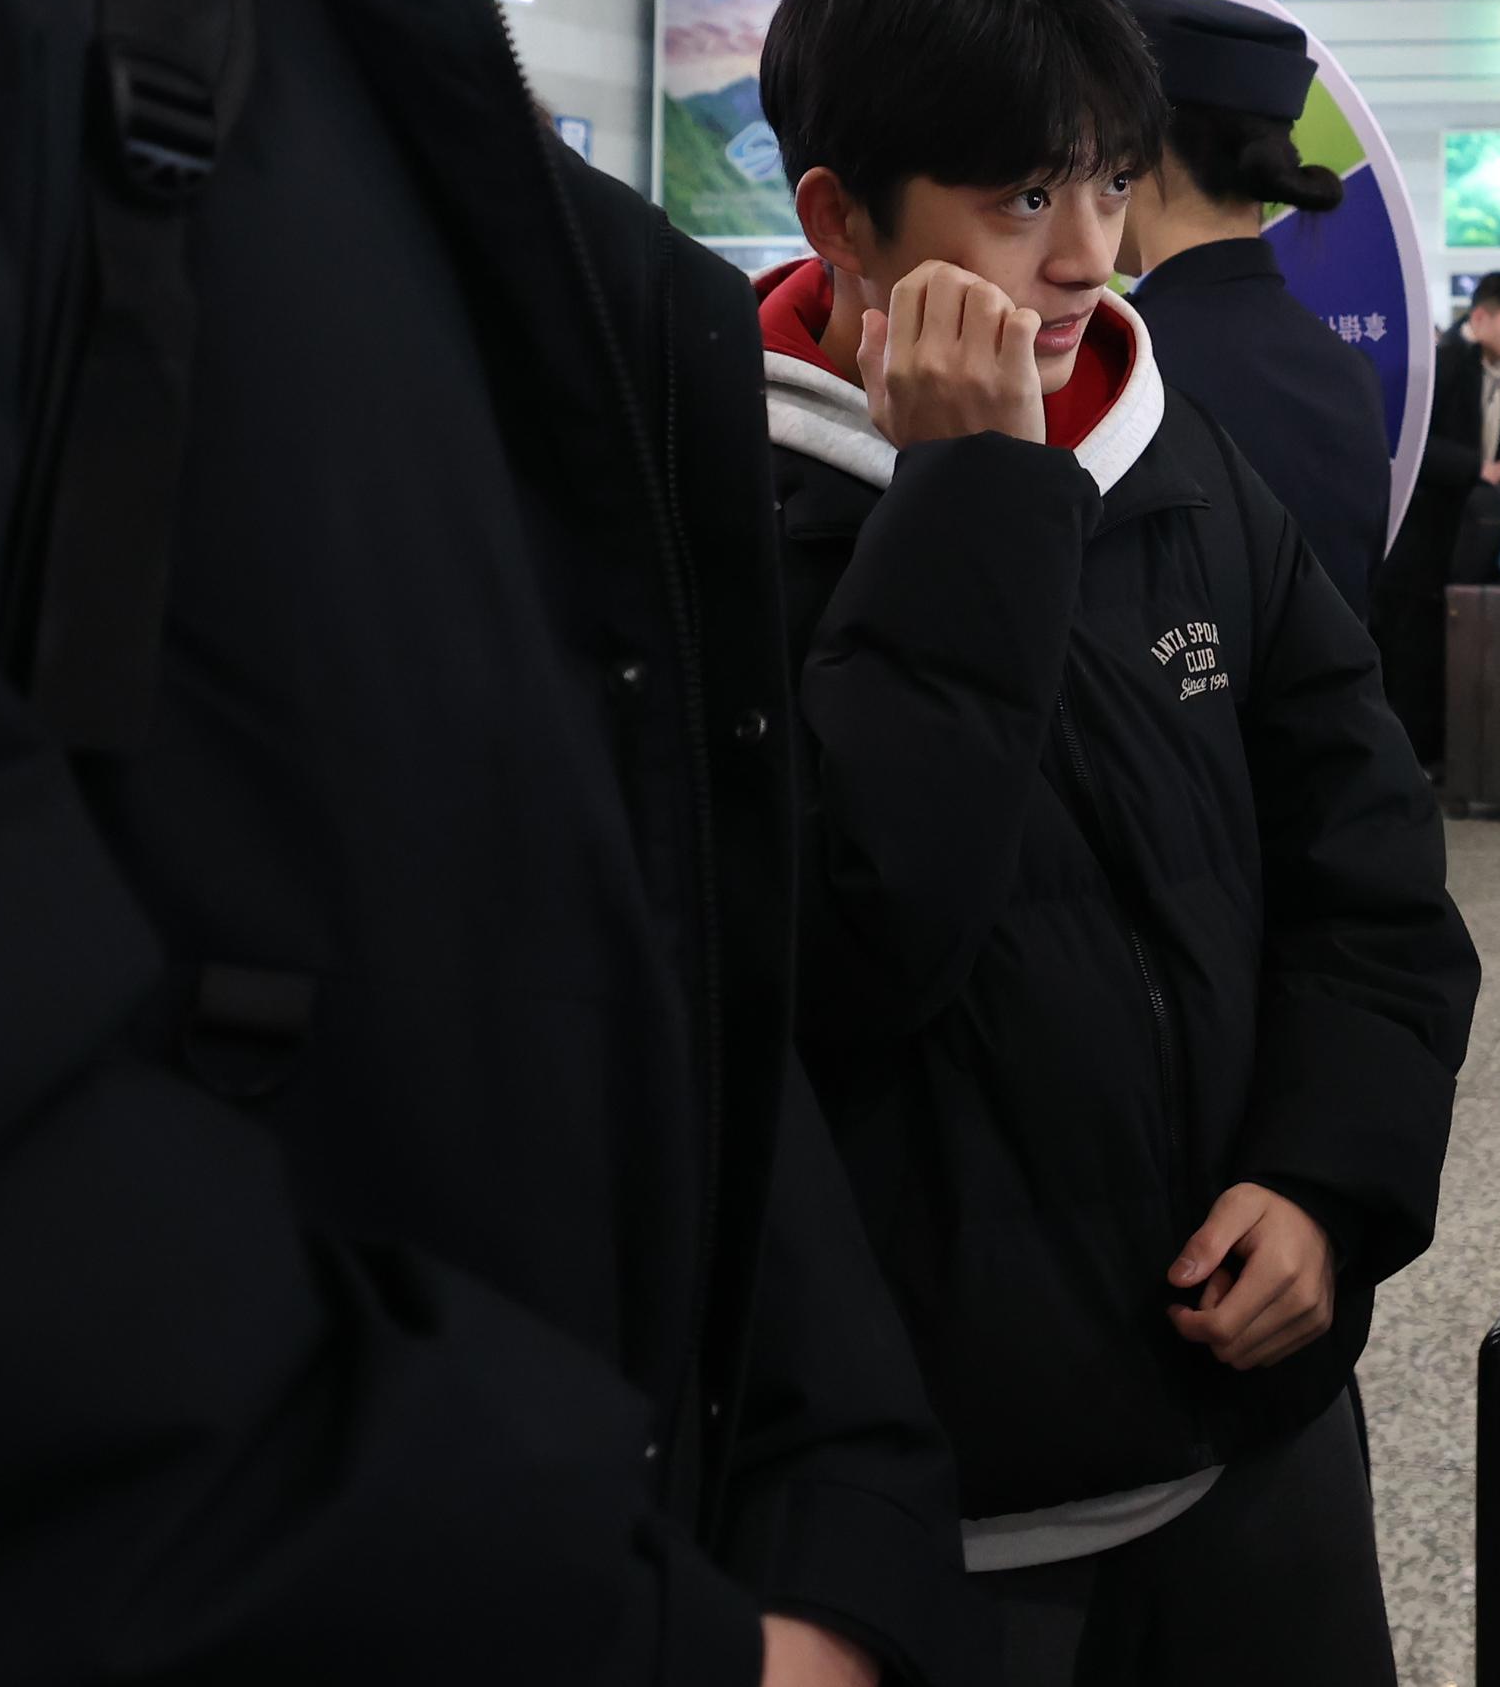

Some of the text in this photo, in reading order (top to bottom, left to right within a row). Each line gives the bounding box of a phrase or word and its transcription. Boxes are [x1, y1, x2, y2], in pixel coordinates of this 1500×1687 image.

[1319, 312, 1388, 343] 拿错
[1150, 627, 1188, 666] ANTA
[1185, 647, 1216, 673] CLUB
[1179, 676, 1207, 701] Since
